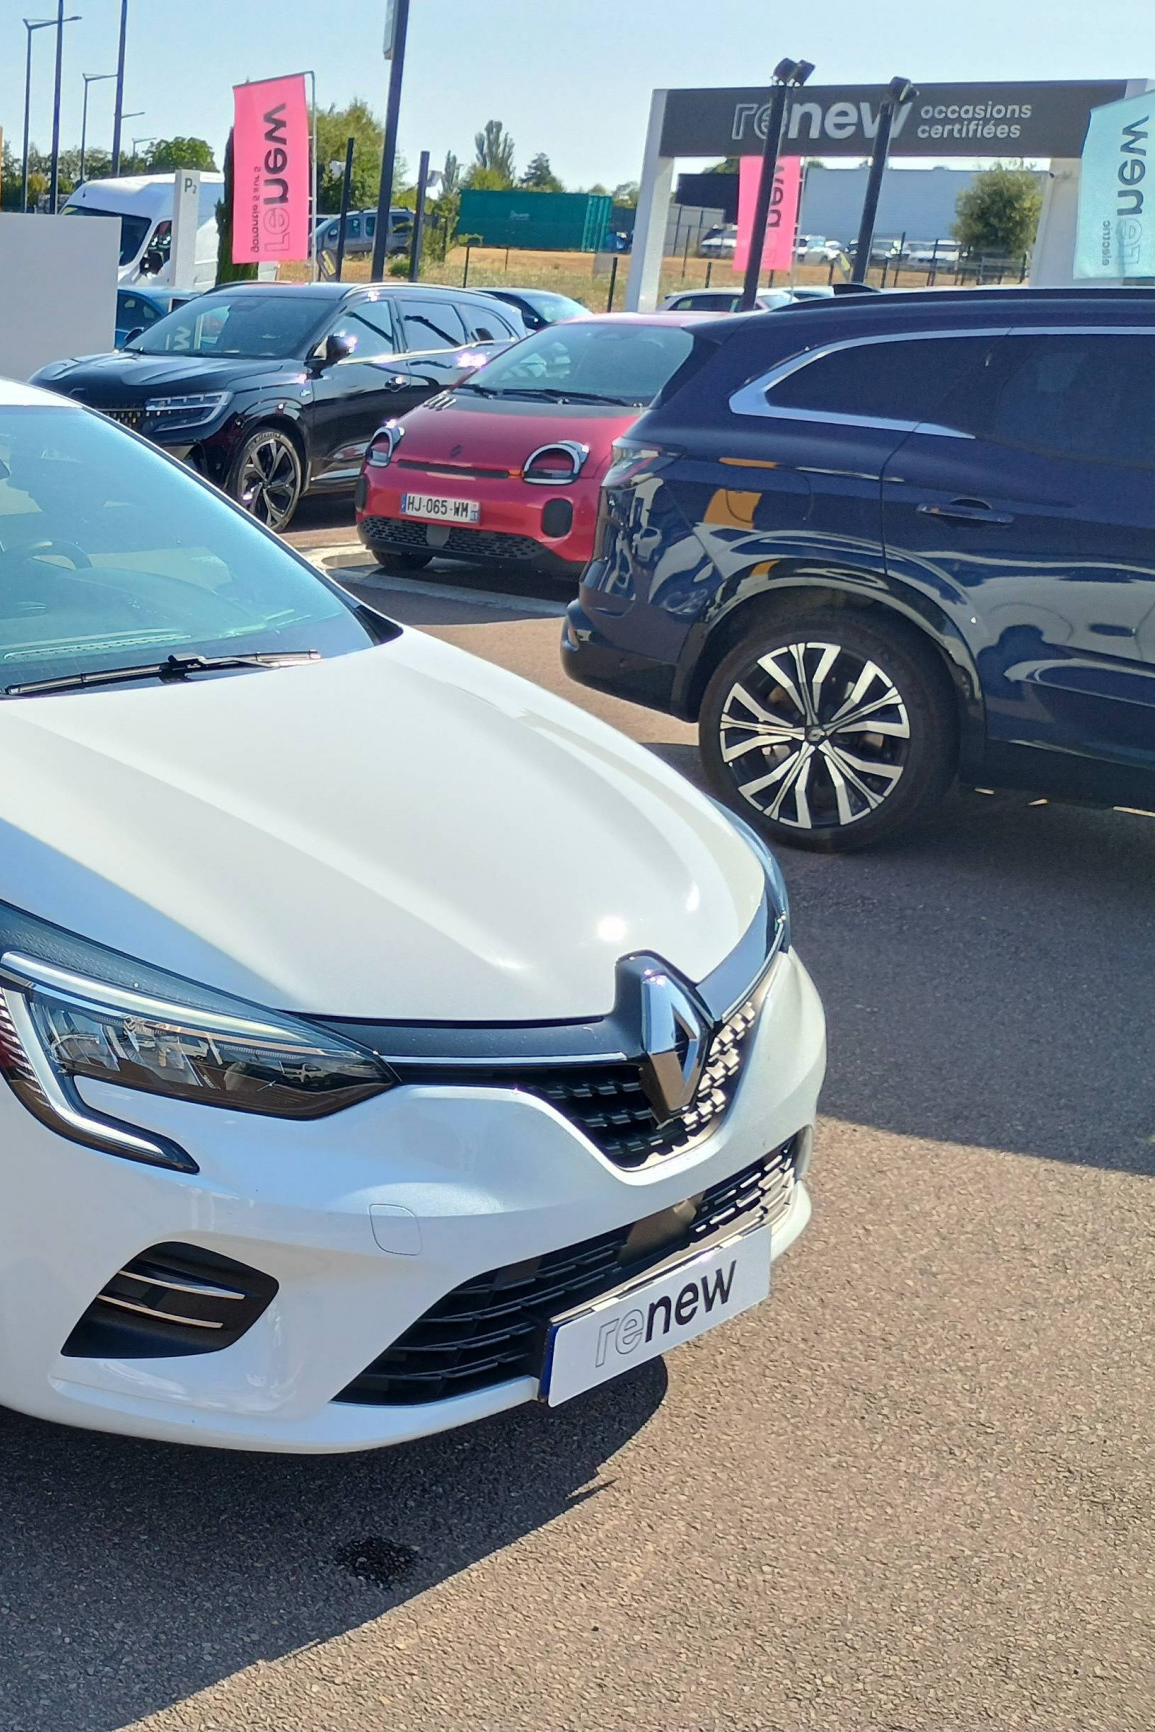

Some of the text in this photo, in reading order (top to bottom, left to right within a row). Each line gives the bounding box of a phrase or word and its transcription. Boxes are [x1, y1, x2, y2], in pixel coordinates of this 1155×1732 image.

[921, 101, 1032, 119] occasions
[917, 121, 1022, 139] certifiées
[595, 1260, 737, 1368] renew
